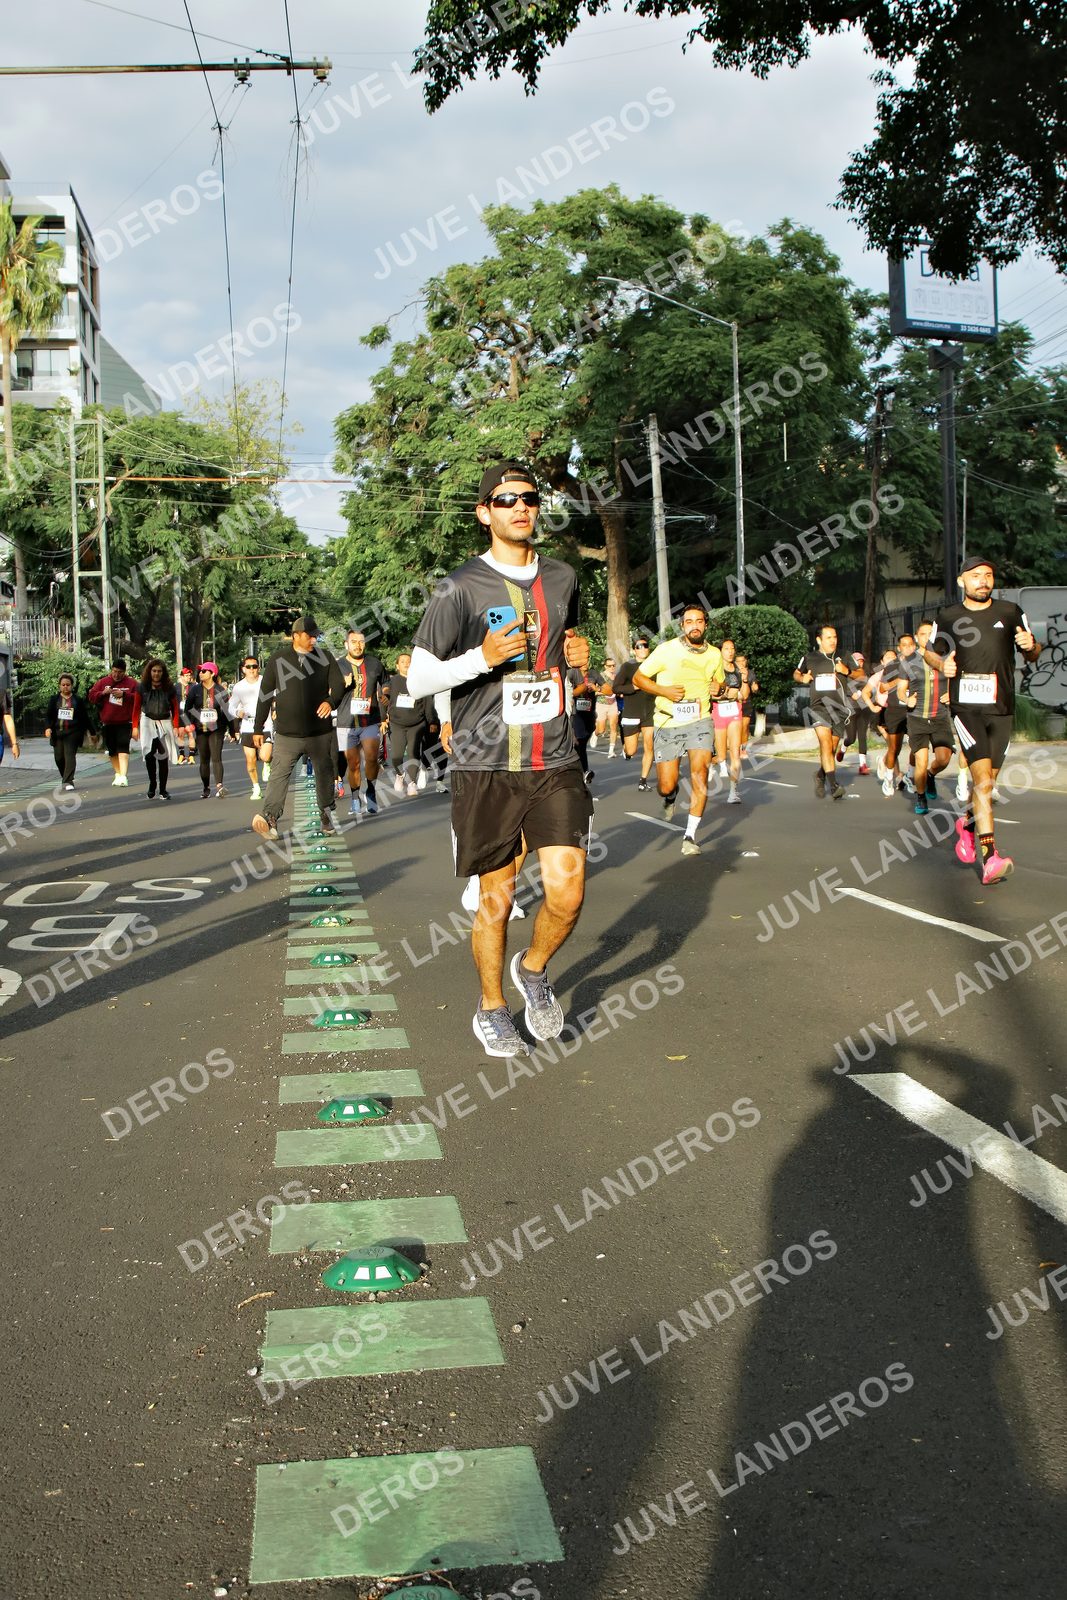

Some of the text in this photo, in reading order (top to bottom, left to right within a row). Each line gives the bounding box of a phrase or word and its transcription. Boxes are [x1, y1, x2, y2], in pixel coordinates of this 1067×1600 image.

[963, 683, 992, 693] 10436
[511, 687, 550, 707] 9792
[676, 705, 695, 714] 9401
